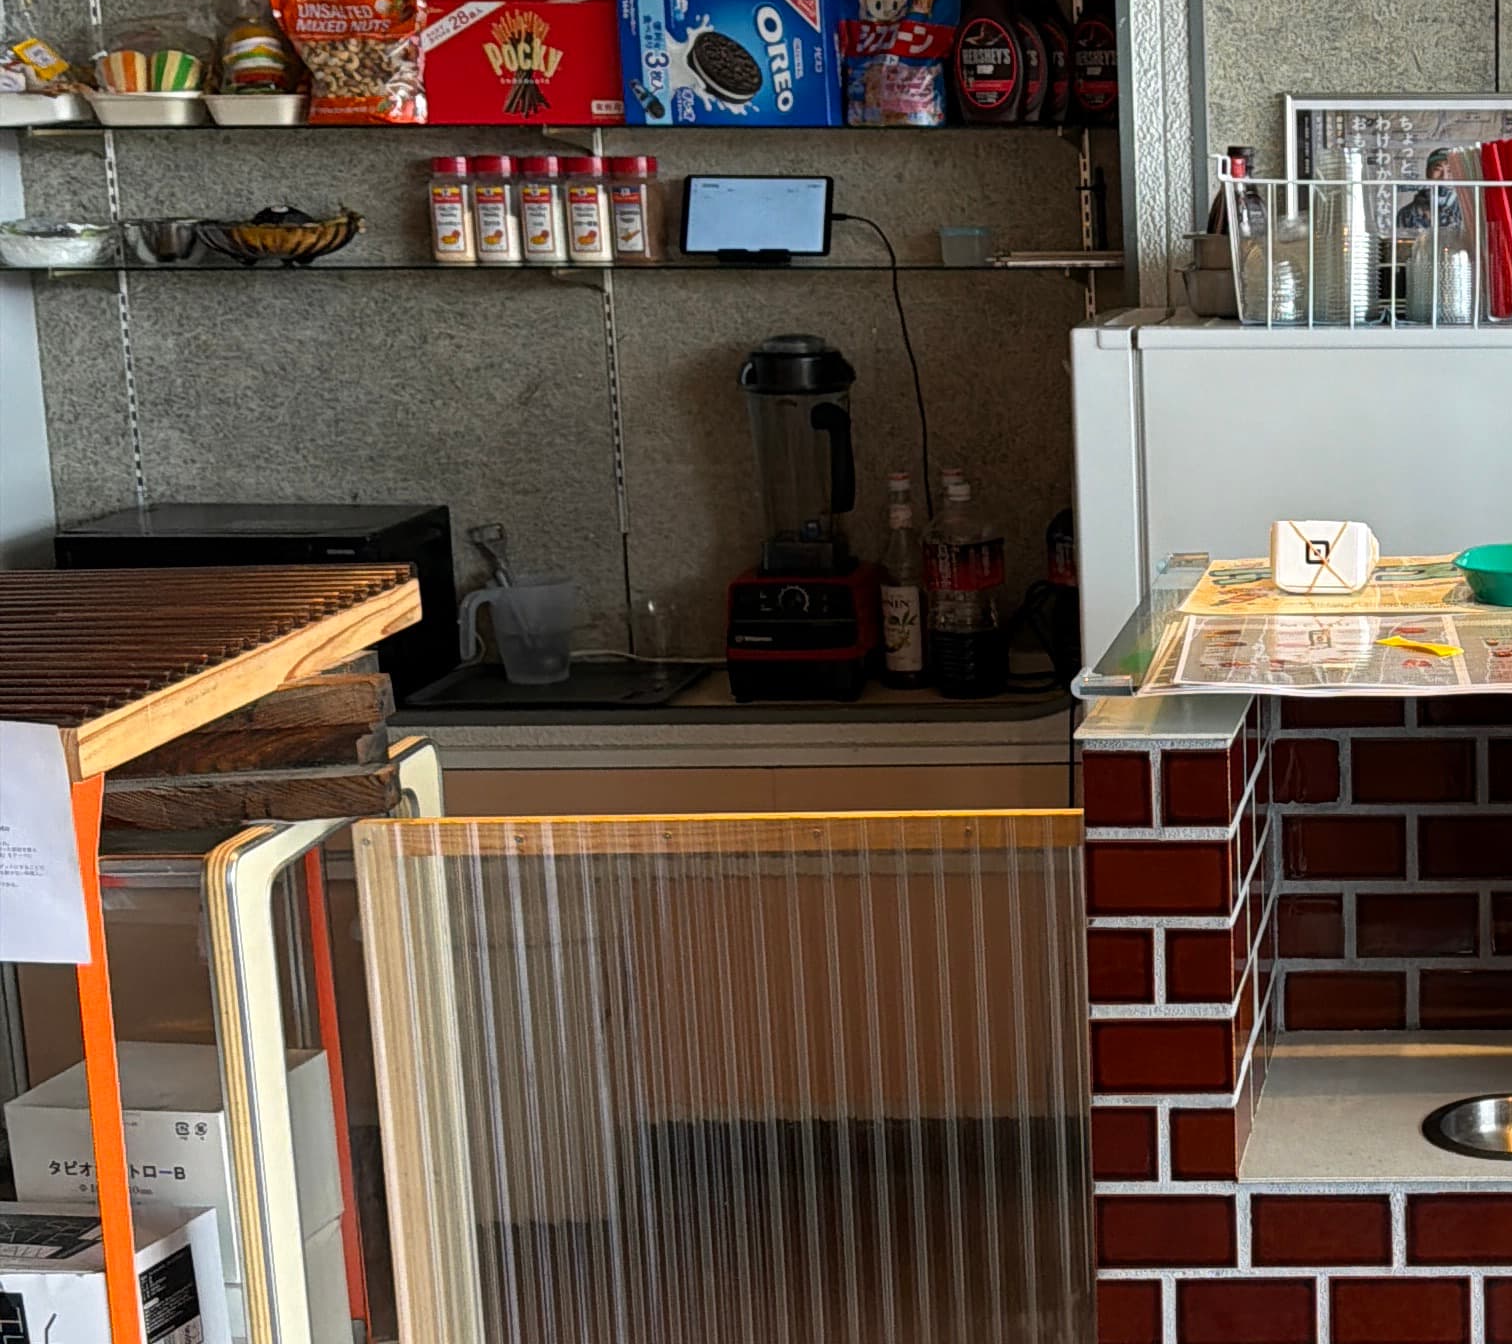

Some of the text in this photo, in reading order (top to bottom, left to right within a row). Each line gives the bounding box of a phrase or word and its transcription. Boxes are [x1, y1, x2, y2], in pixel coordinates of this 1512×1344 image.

[297, 4, 373, 20] UNSALTED
[296, 18, 392, 33] MIXED NUTS
[856, 24, 933, 54] シスコーン
[756, 6, 794, 112] OREO
[962, 48, 1011, 65] HERSHEY'S
[1400, 115, 1414, 175] ちょっと
[1375, 115, 1393, 230] わけわかんない
[49, 1160, 187, 1180] タピオトローB
